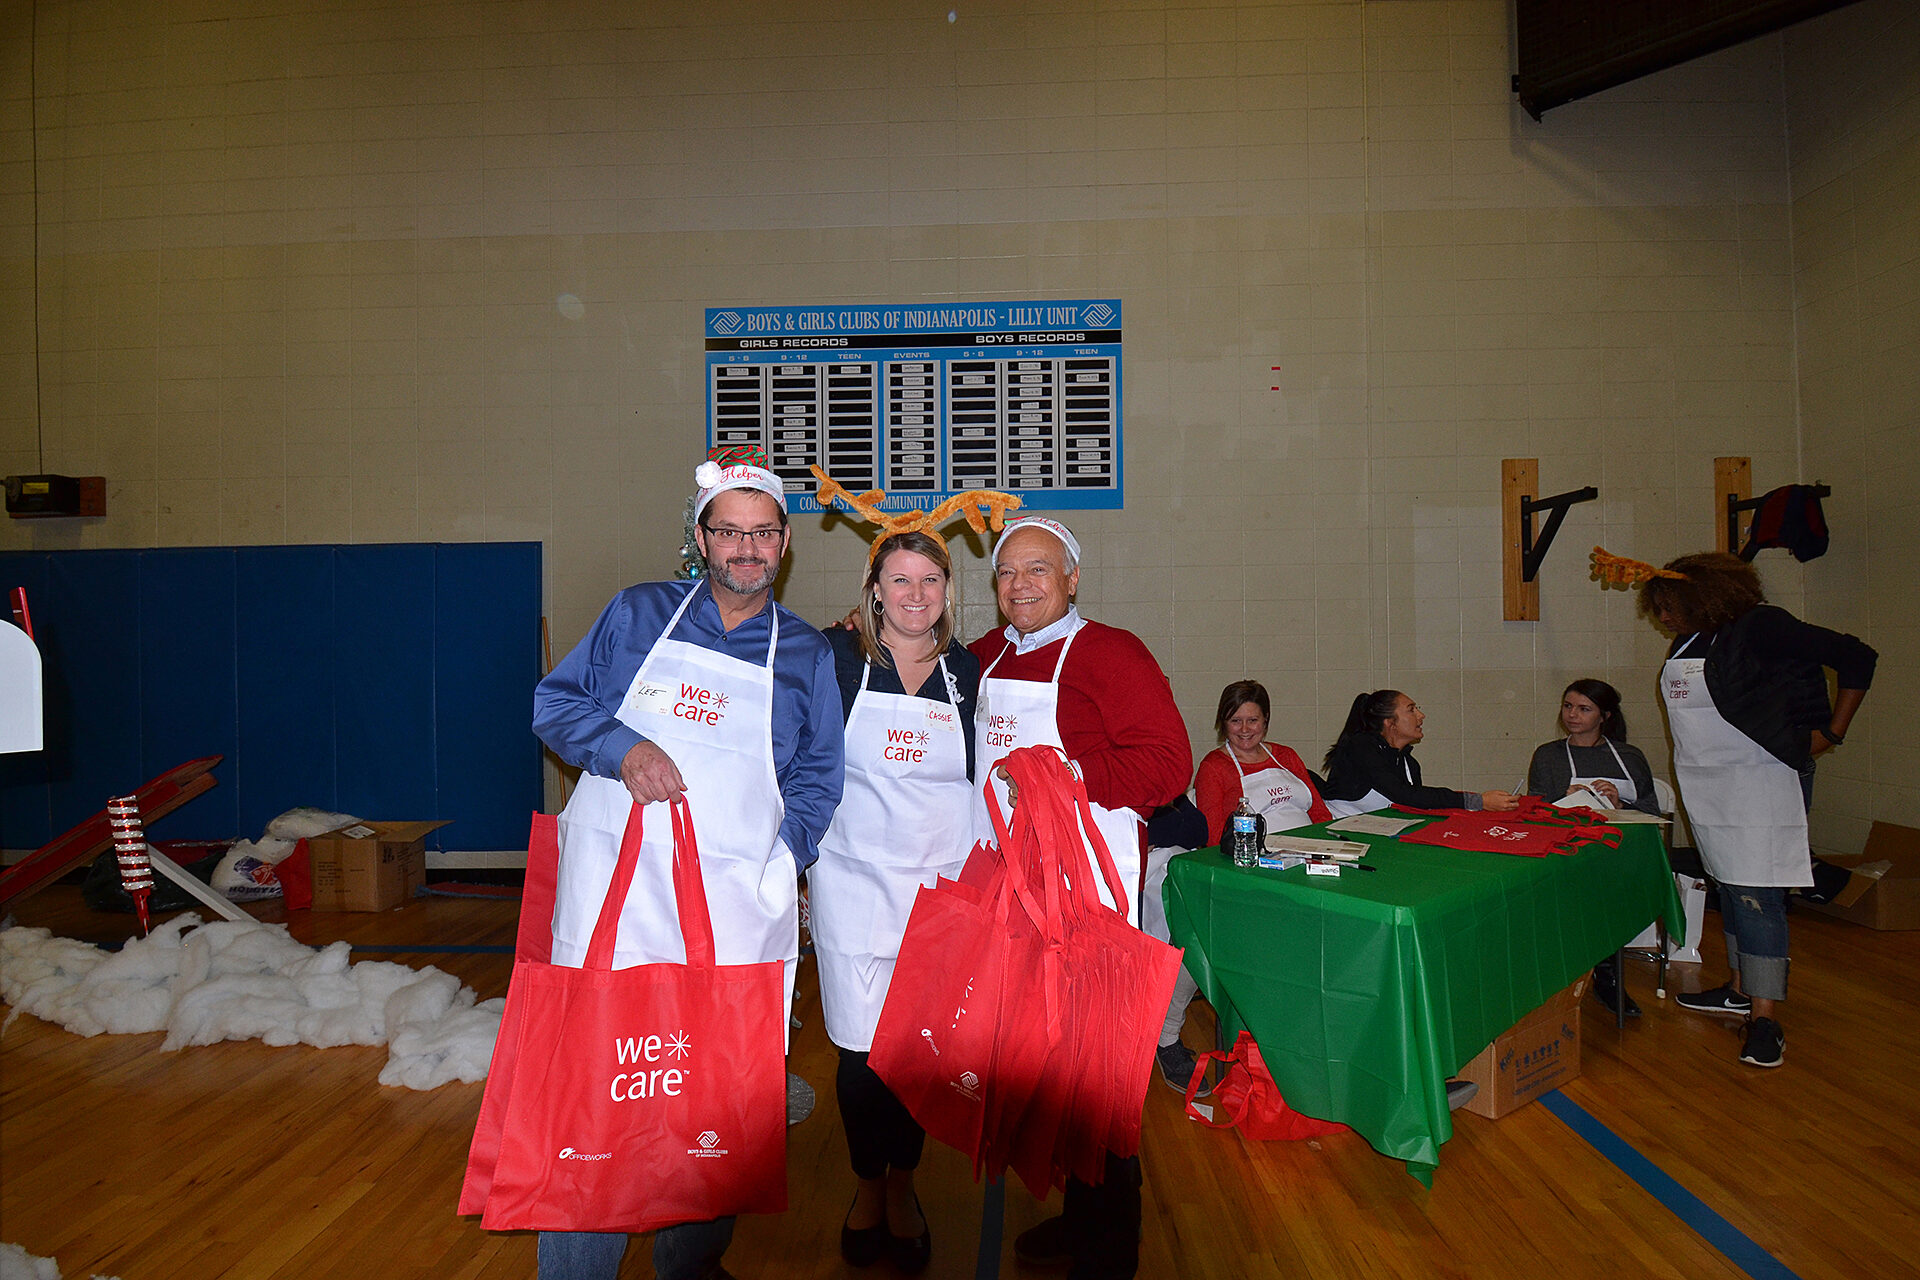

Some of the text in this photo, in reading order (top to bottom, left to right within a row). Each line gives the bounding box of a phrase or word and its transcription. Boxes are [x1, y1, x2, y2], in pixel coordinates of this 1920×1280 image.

[747, 313, 781, 331] BOYS
[784, 312, 795, 330] &
[798, 312, 836, 330] GIRLS
[839, 311, 880, 329] CLUBS
[883, 311, 900, 328] OF
[904, 308, 997, 328] INDIANAPOLIS
[1008, 307, 1043, 326] LILLY
[1047, 306, 1079, 325] UNIT
[739, 338, 849, 348] GIRLS RECORDS
[975, 333, 1086, 343] BOYS RECORDS
[719, 465, 764, 484] Helper
[875, 495, 930, 510] OMMUNITY
[637, 685, 667, 697] LEE
[681, 682, 711, 705] we
[673, 702, 719, 726] care
[928, 710, 953, 723] CASSIE
[887, 728, 914, 744] we
[986, 731, 1013, 748] care
[883, 746, 923, 763] care
[1266, 786, 1284, 797] we
[615, 1034, 662, 1065] we
